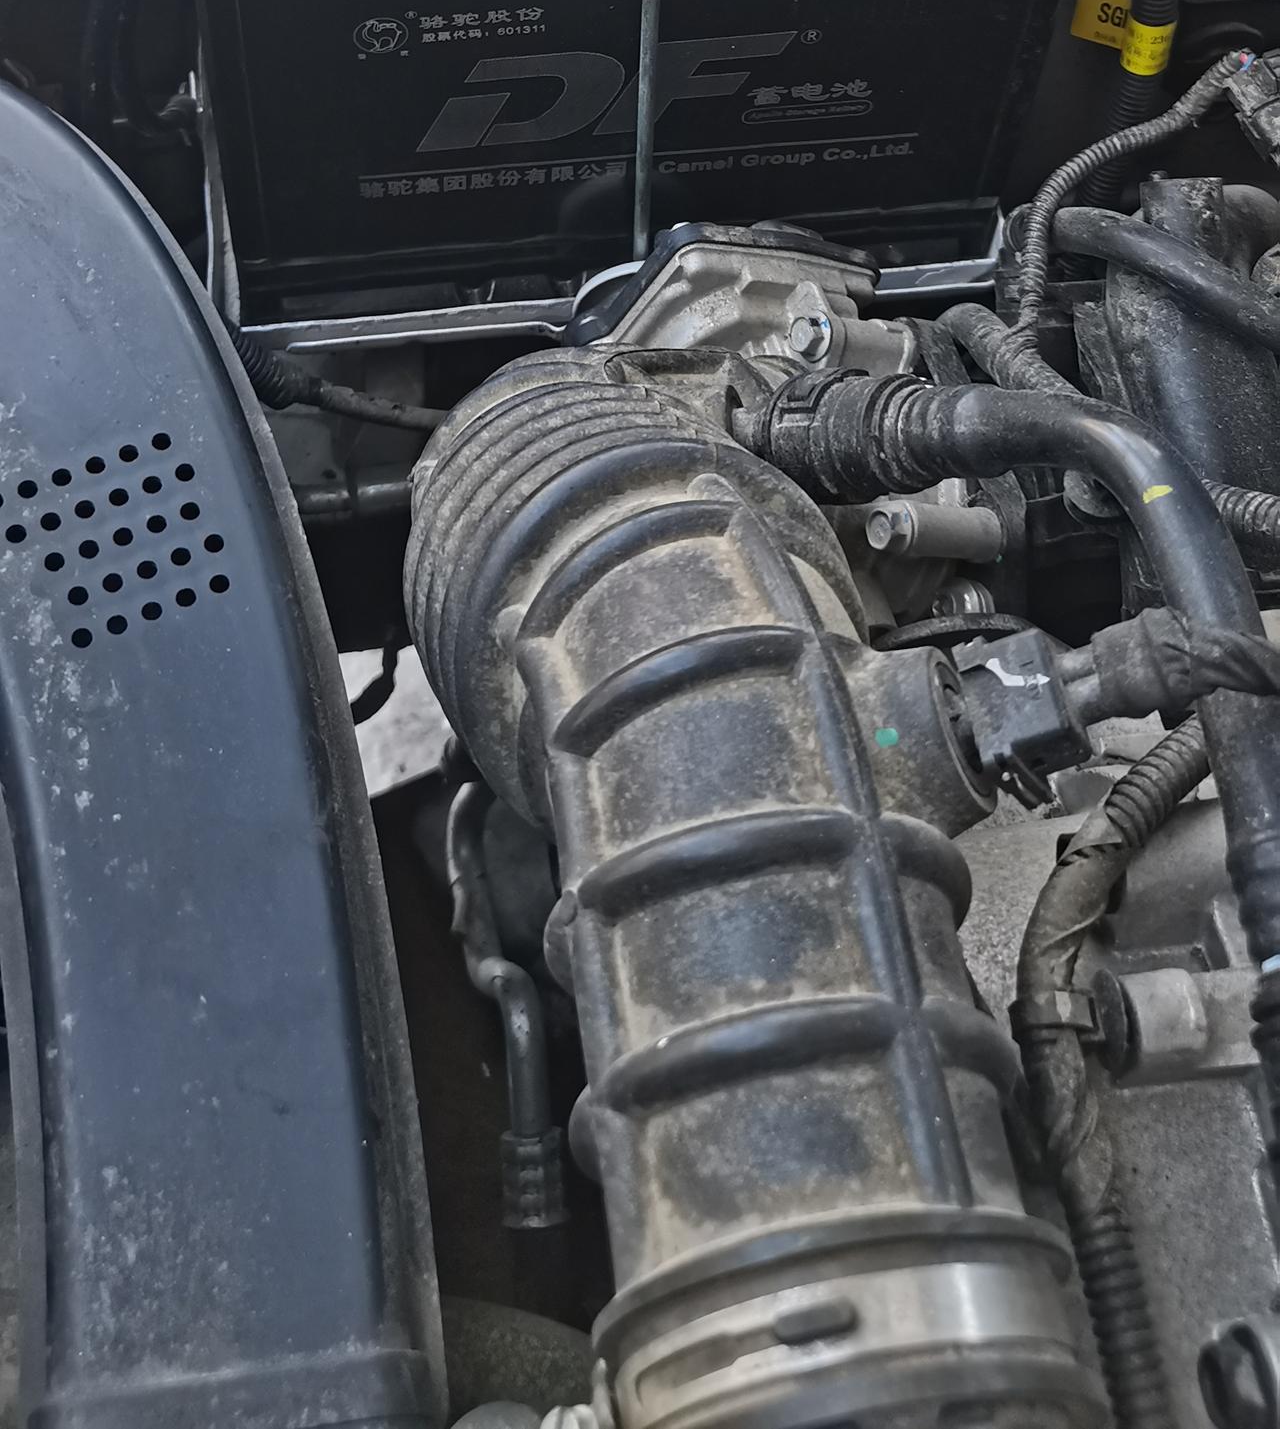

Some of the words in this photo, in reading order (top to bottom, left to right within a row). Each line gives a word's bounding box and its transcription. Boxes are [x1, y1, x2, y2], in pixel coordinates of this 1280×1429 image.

[418, 6, 546, 30] 骆驼股份
[746, 78, 874, 107] 蓄电池
[658, 154, 735, 175] Camel
[740, 146, 816, 171] Group
[822, 140, 915, 164] Co.,Ltd.
[358, 160, 629, 201] 骆驼集团股份有限公司
